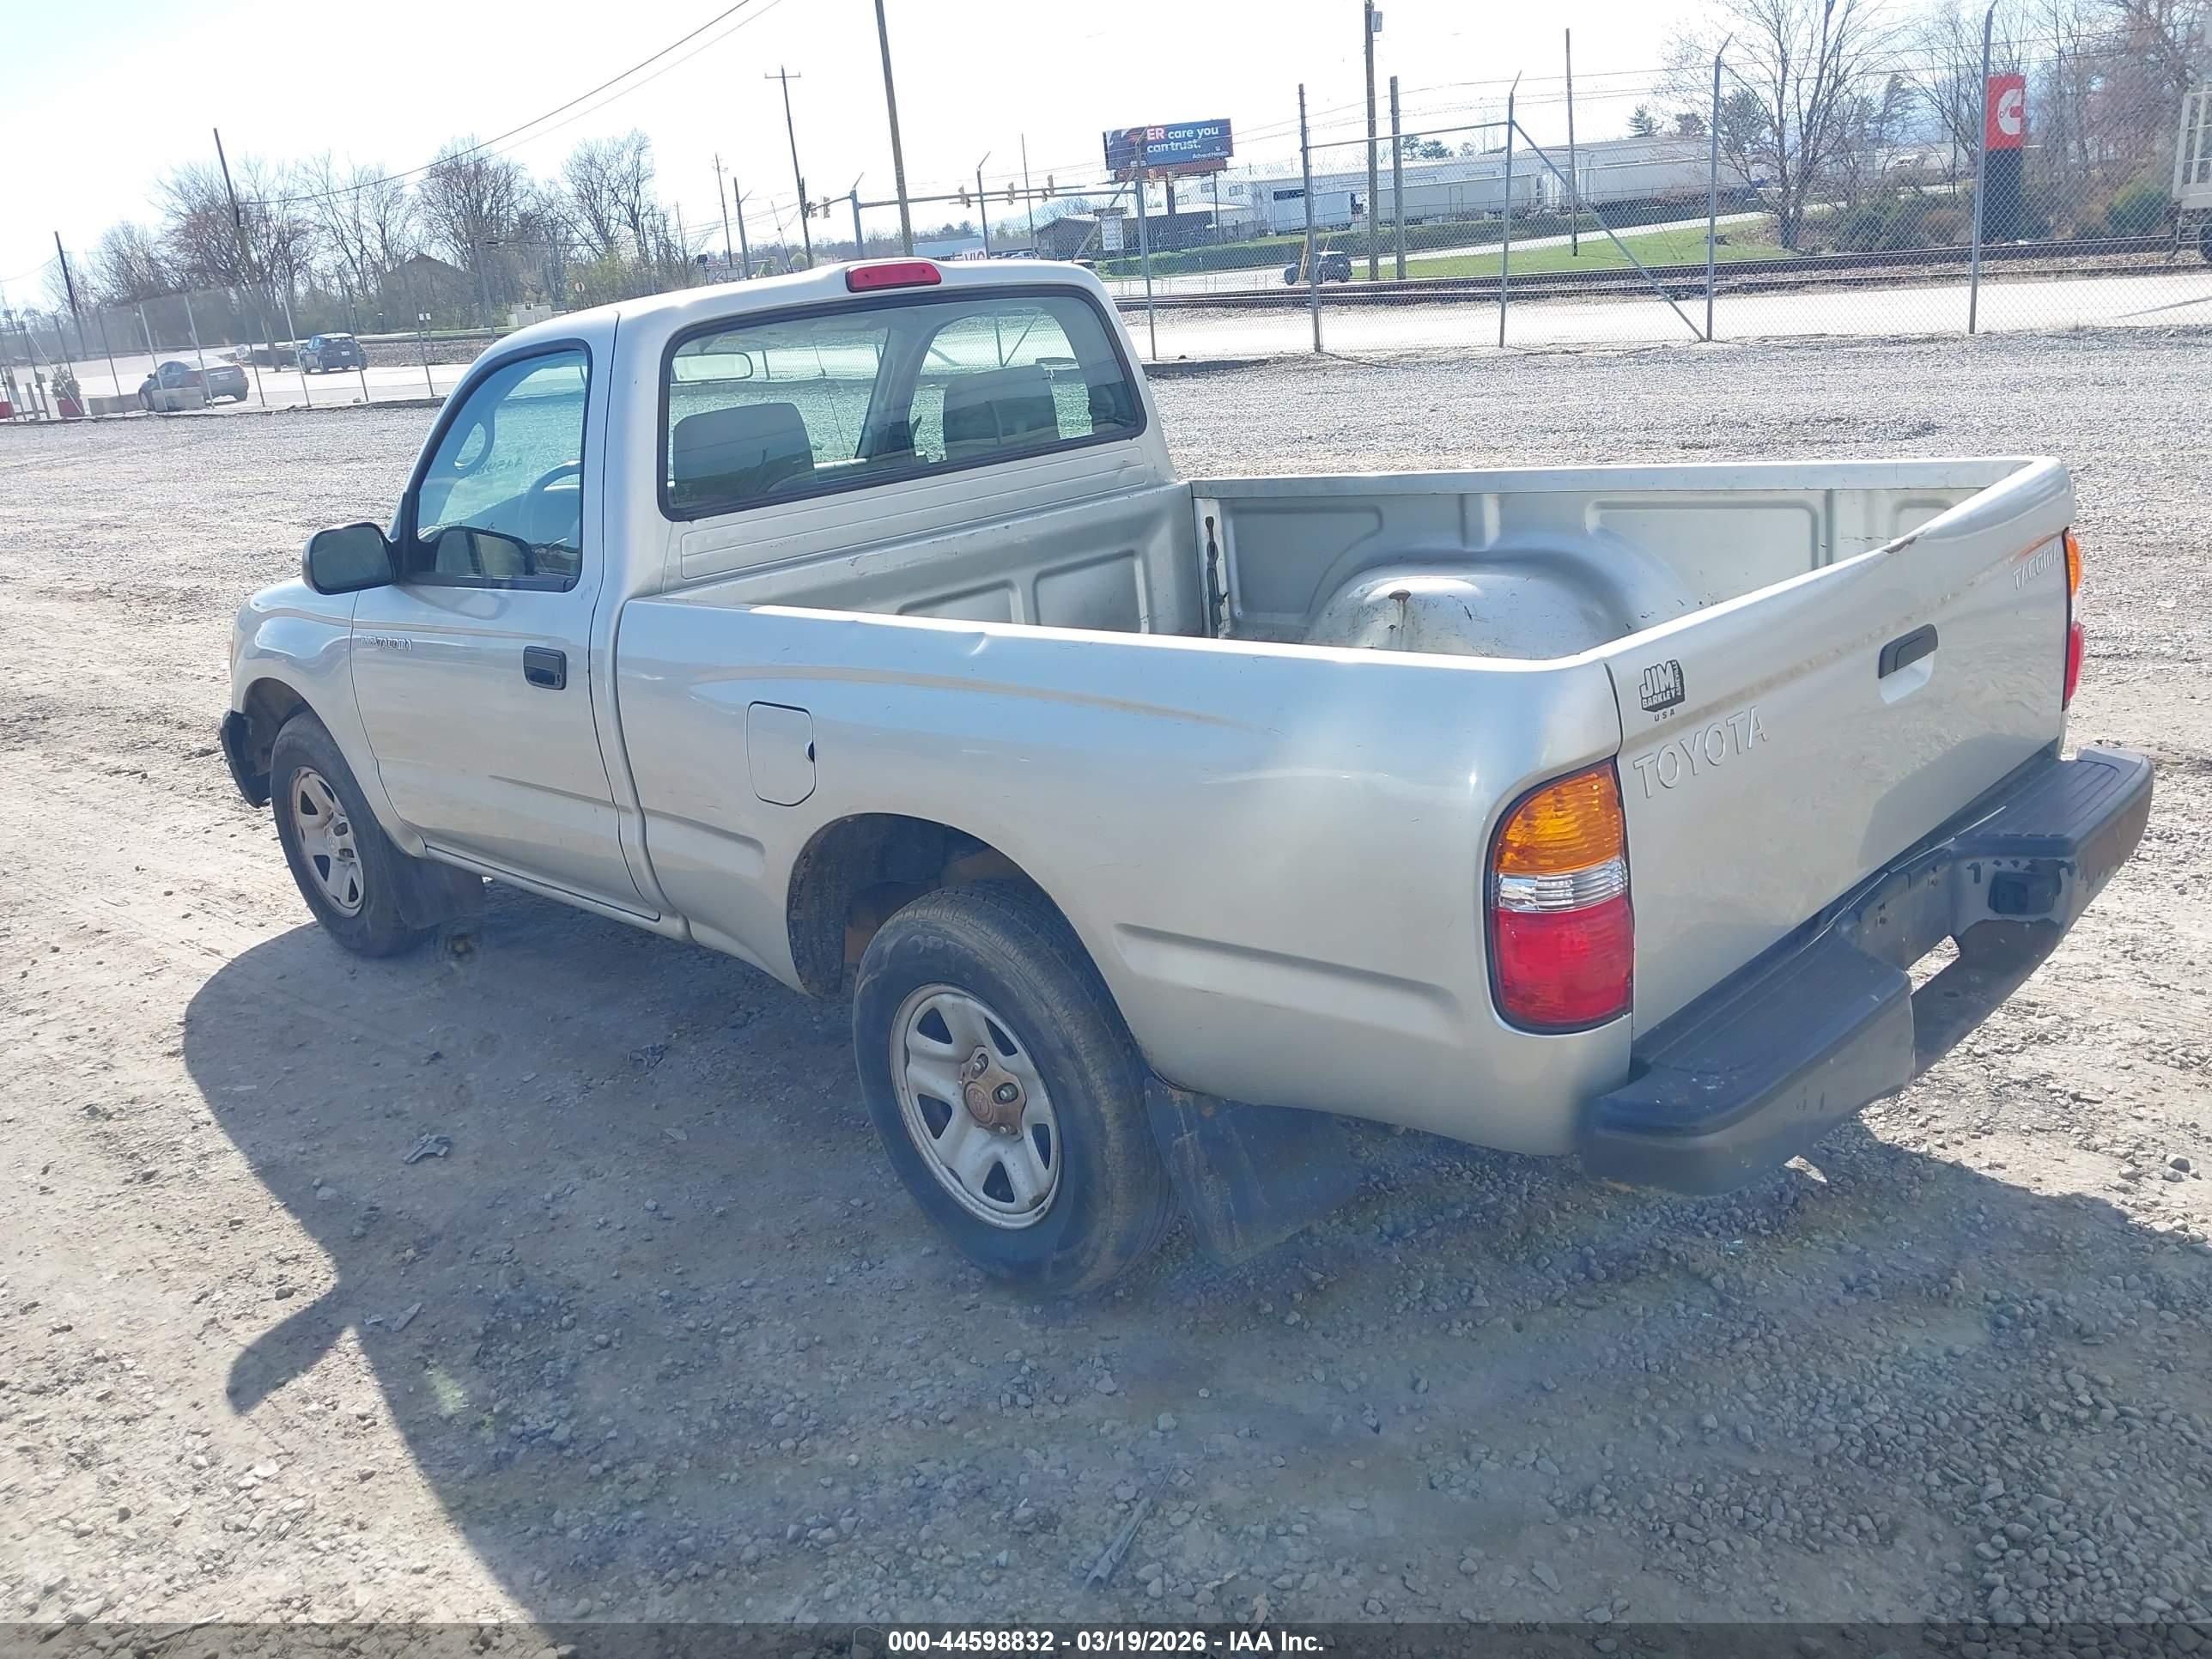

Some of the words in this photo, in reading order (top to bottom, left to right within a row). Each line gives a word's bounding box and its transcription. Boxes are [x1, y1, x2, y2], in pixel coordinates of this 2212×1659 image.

[1146, 127, 1165, 141] ER
[1168, 129, 1194, 139] care
[1197, 126, 1219, 139] you
[2013, 543, 2061, 590] TACOMA
[1639, 660, 1675, 698] JIM
[1641, 688, 1676, 709] BARKLEY
[1633, 705, 1770, 799] TOYOTA
